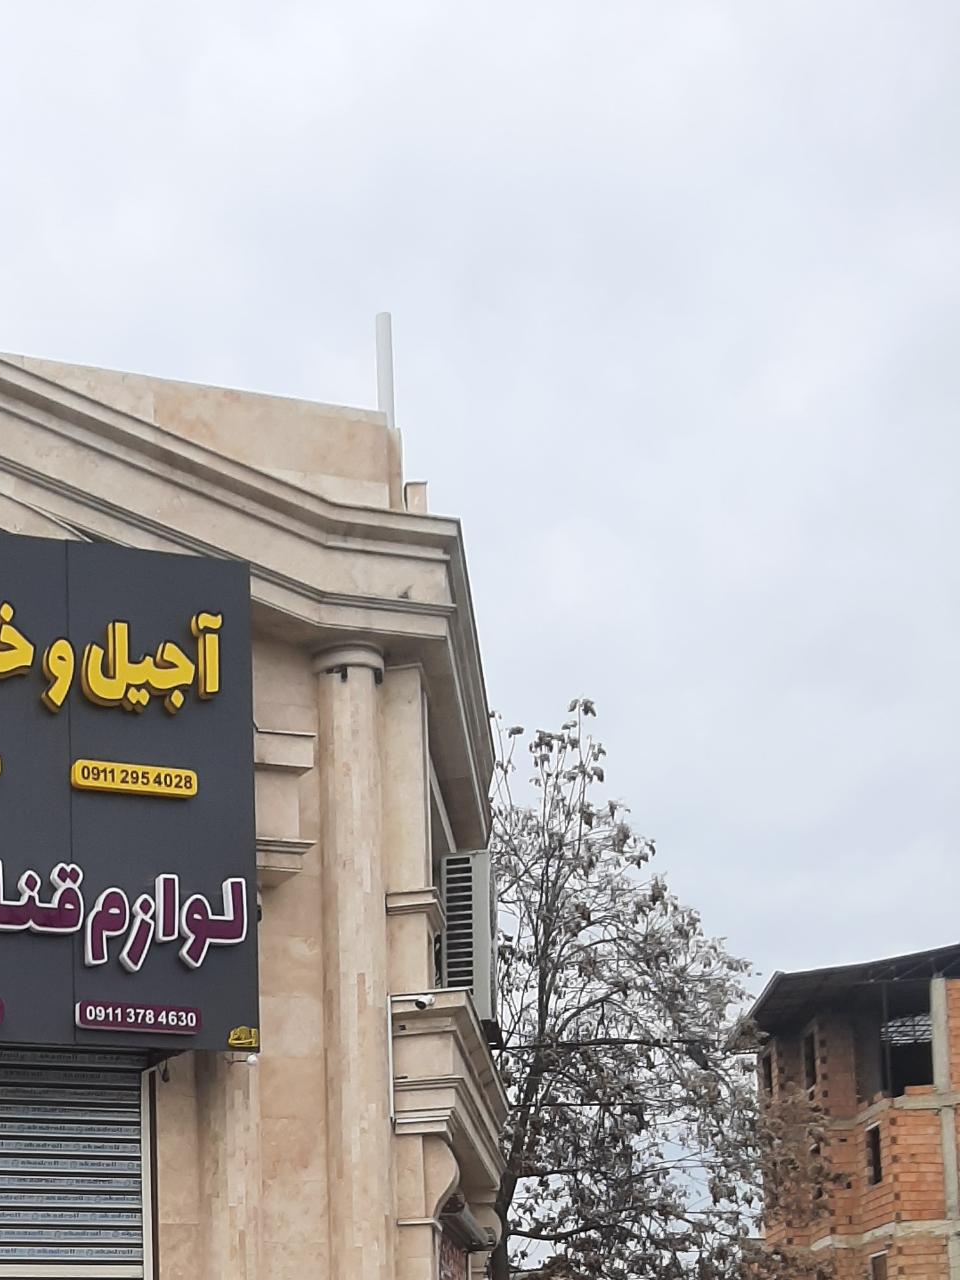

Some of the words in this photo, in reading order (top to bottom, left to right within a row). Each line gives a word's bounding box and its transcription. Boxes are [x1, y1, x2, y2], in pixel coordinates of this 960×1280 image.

[42, 637, 76, 712] و
[82, 612, 223, 713] آجیل
[81, 764, 116, 784] 0911
[120, 768, 150, 787] 295
[153, 771, 193, 790] 4028
[85, 873, 248, 973] لوازم
[85, 1005, 122, 1023] 0911
[126, 1008, 155, 1025] 378
[157, 1010, 197, 1028] 4630
